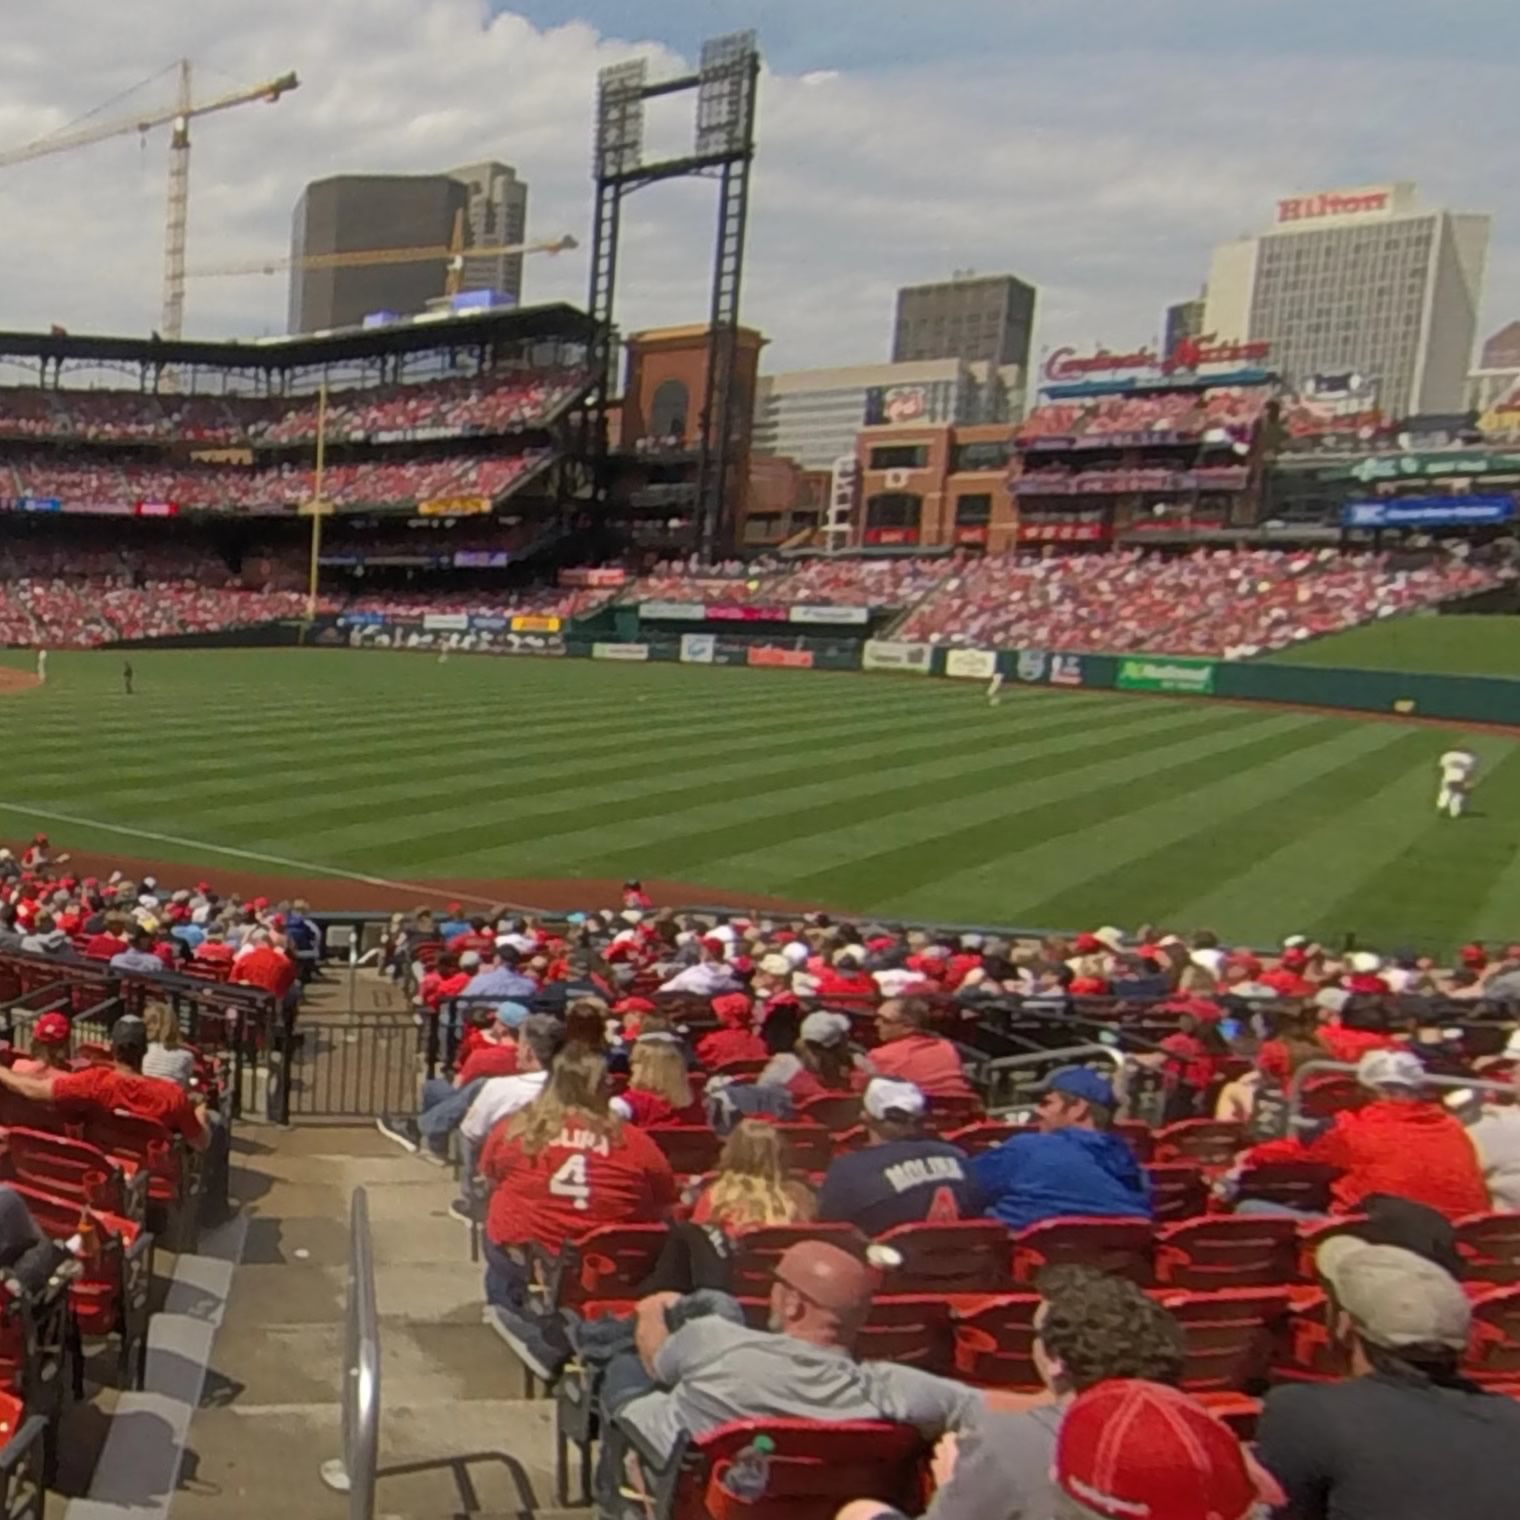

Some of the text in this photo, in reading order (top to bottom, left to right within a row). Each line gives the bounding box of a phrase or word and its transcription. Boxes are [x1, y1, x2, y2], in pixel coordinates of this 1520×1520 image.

[1277, 193, 1387, 222] Hilton
[548, 1127, 609, 1157] LINA
[549, 1153, 590, 1211] 4
[884, 1156, 964, 1193] MOLINA
